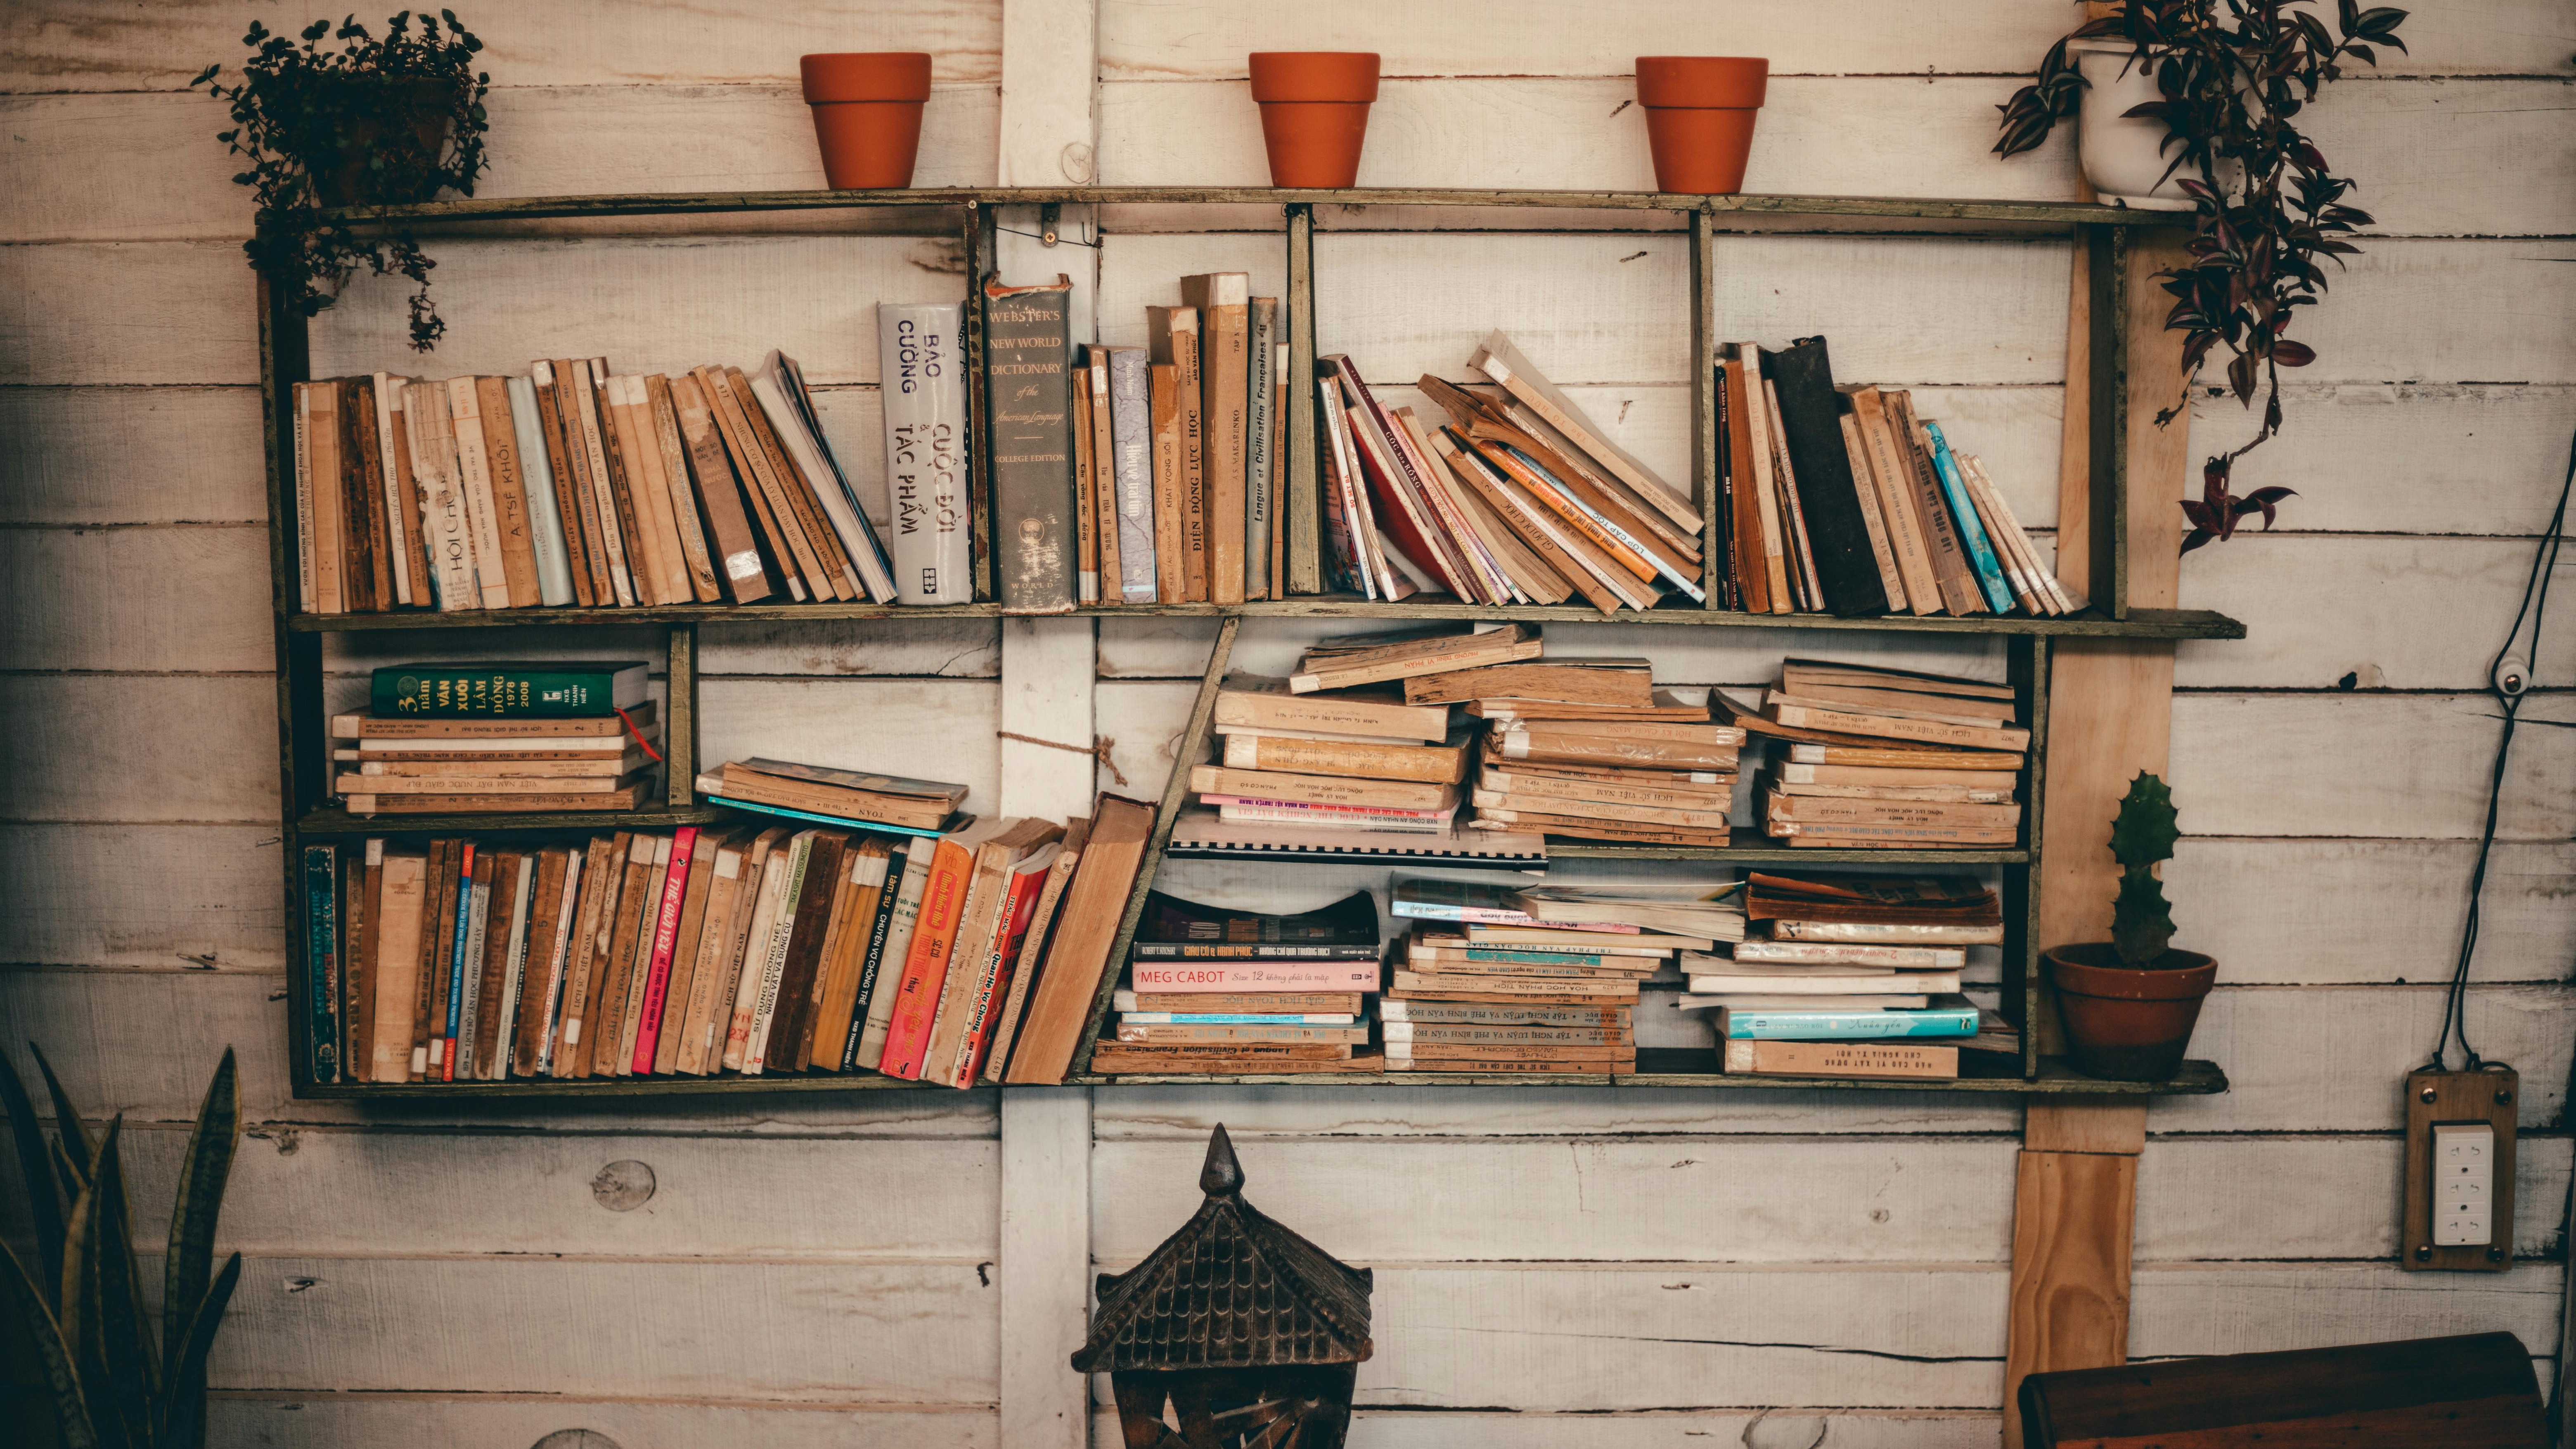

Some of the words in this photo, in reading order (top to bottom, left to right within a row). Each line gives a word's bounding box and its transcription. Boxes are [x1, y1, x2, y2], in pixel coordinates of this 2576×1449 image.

[989, 310, 1060, 323] WEBSTER'S
[990, 339, 1016, 348] NEW
[1017, 336, 1061, 348] WORLD
[897, 320, 921, 393] CƯỜNG
[923, 334, 946, 377] BẢO
[991, 363, 1062, 374] DICTIONARY
[1257, 341, 1267, 399] Françaises
[1014, 386, 1029, 400] of
[1026, 384, 1039, 396] the
[992, 410, 1029, 424] American
[1023, 410, 1064, 426] Language
[1188, 410, 1198, 437] HỌC
[895, 423, 923, 464] TÁC
[1255, 405, 1265, 464] Civilisation
[926, 423, 959, 485] CUỘC
[994, 454, 1028, 462] COLLEGE
[1189, 445, 1200, 470] LỰC
[1257, 469, 1263, 477] et
[897, 473, 928, 535] PHẨM
[1187, 477, 1202, 514] ĐỘNG
[1254, 483, 1264, 521] Langue
[935, 492, 963, 533] ĐỜI
[1189, 521, 1203, 551] ĐIỆN
[417, 680, 429, 709] năm
[436, 680, 449, 706] VĂN
[454, 680, 468, 710] XUÔI
[473, 680, 485, 708] LÂM
[507, 682, 515, 706] 1978
[521, 681, 529, 707] 2008
[886, 874, 898, 893] tâm
[881, 895, 891, 908] sự
[872, 914, 888, 947] CHUYỆN
[869, 947, 879, 959] VỢ
[752, 1018, 761, 1032] SỬ
[757, 985, 768, 1015] DỤNG
[763, 945, 777, 983] ĐƯỜNG
[772, 921, 781, 942] NÉT
[862, 959, 878, 989] CHỒNG
[1141, 971, 1171, 982] MEG
[1177, 971, 1224, 982] CABOT
[1252, 971, 1263, 980] 12
[1266, 973, 1286, 983] không
[1288, 973, 1302, 983] phải
[1314, 974, 1329, 983] mập
[858, 989, 870, 1006] TRẺ
[1503, 1011, 1524, 1020] LUẬN
[1527, 1011, 1549, 1020] NGHỊ
[1552, 1012, 1567, 1020] TẬP
